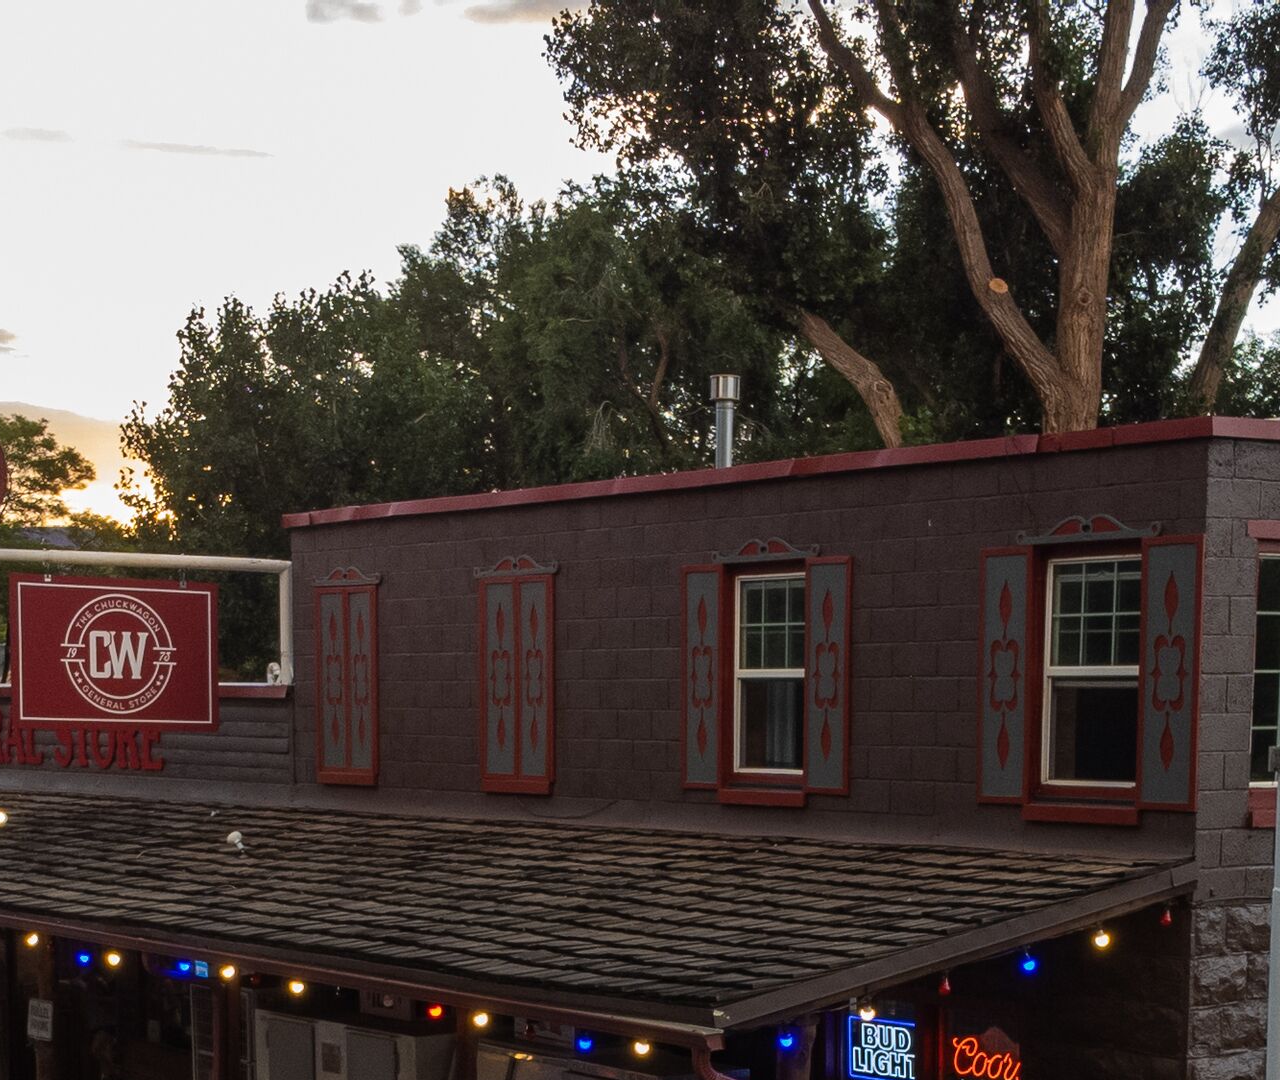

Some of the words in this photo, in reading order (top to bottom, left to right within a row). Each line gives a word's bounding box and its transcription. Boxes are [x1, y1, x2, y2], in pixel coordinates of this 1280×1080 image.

[75, 610, 94, 629] THE
[94, 599, 161, 633] CHUCKWAGON
[66, 647, 78, 658] 19
[89, 630, 149, 679] CW
[159, 651, 171, 662] 73
[82, 684, 125, 710] GENERAL
[128, 686, 158, 709] STORE
[861, 1022, 912, 1053] BUD
